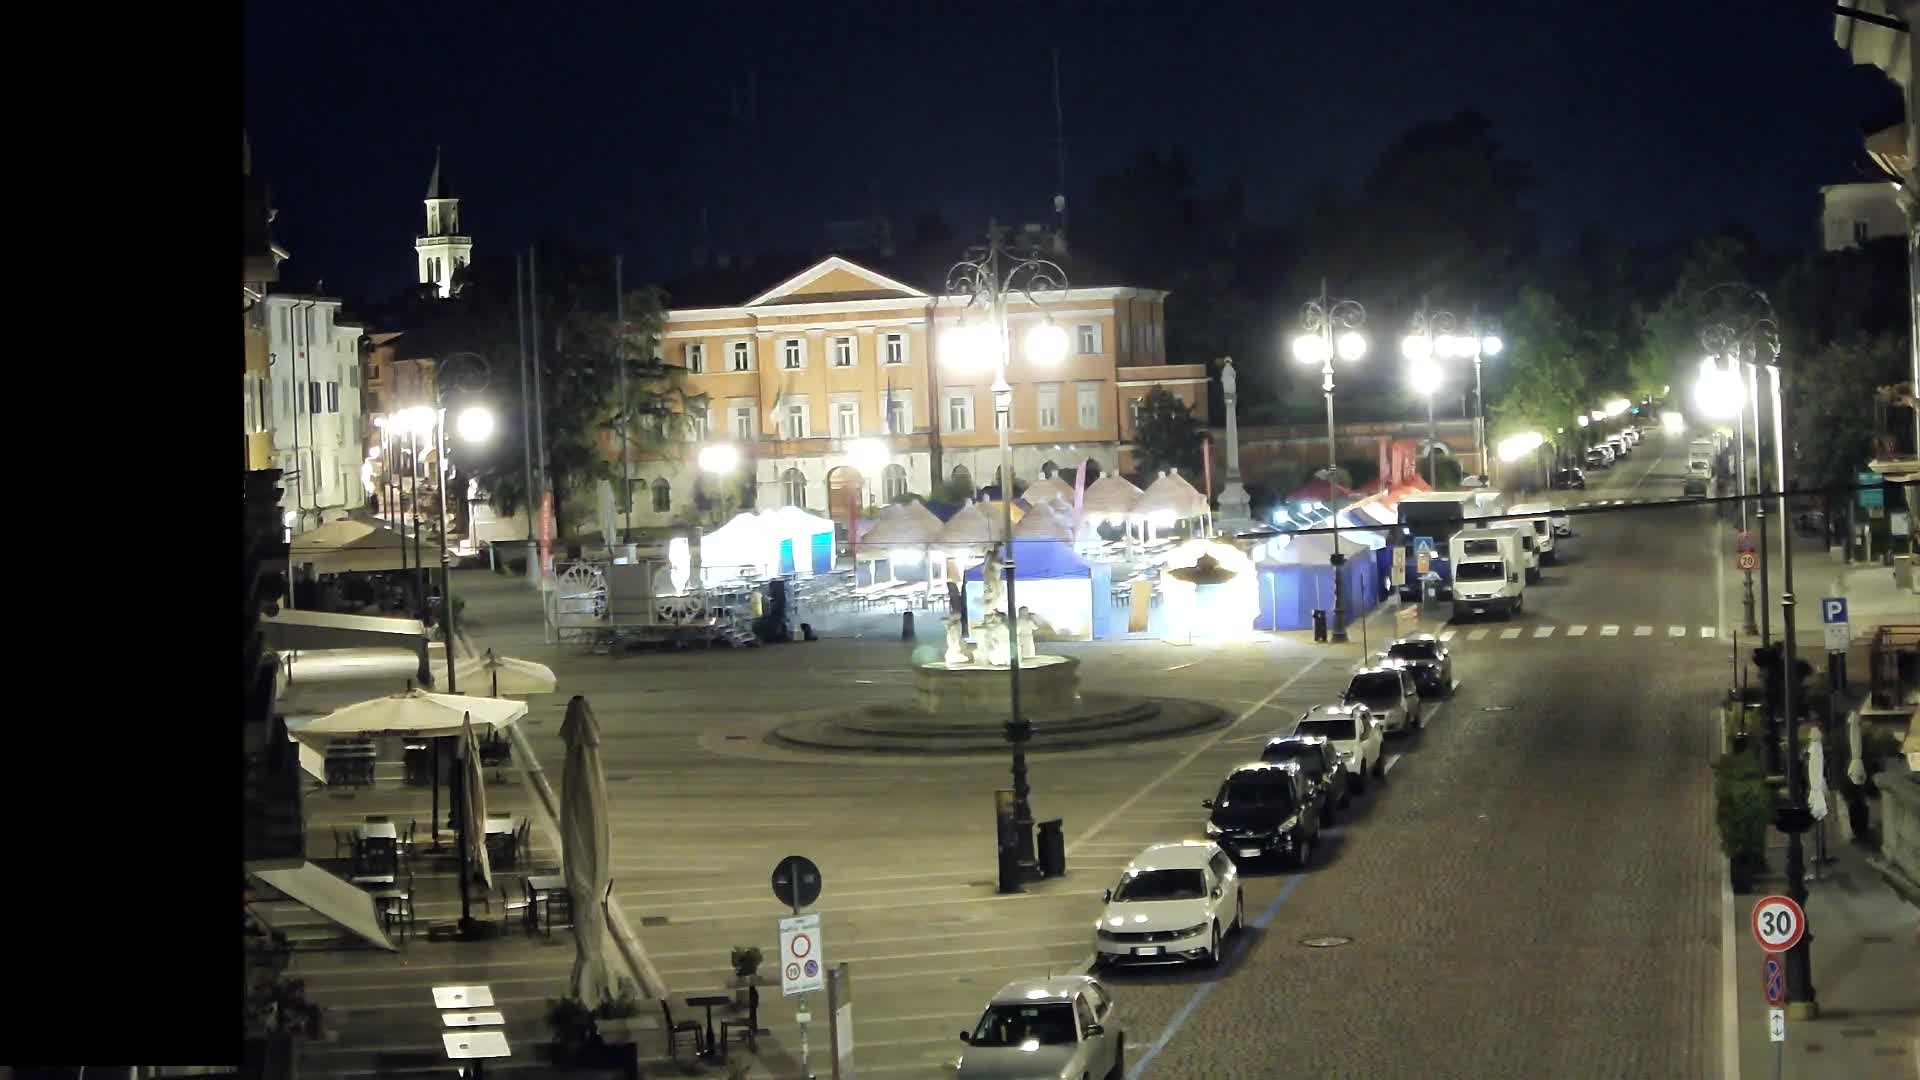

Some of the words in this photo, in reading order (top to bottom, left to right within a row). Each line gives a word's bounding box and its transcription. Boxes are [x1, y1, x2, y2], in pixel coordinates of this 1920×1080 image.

[1743, 558, 1753, 566] 20
[1827, 601, 1842, 621] P
[1763, 911, 1791, 936] 30
